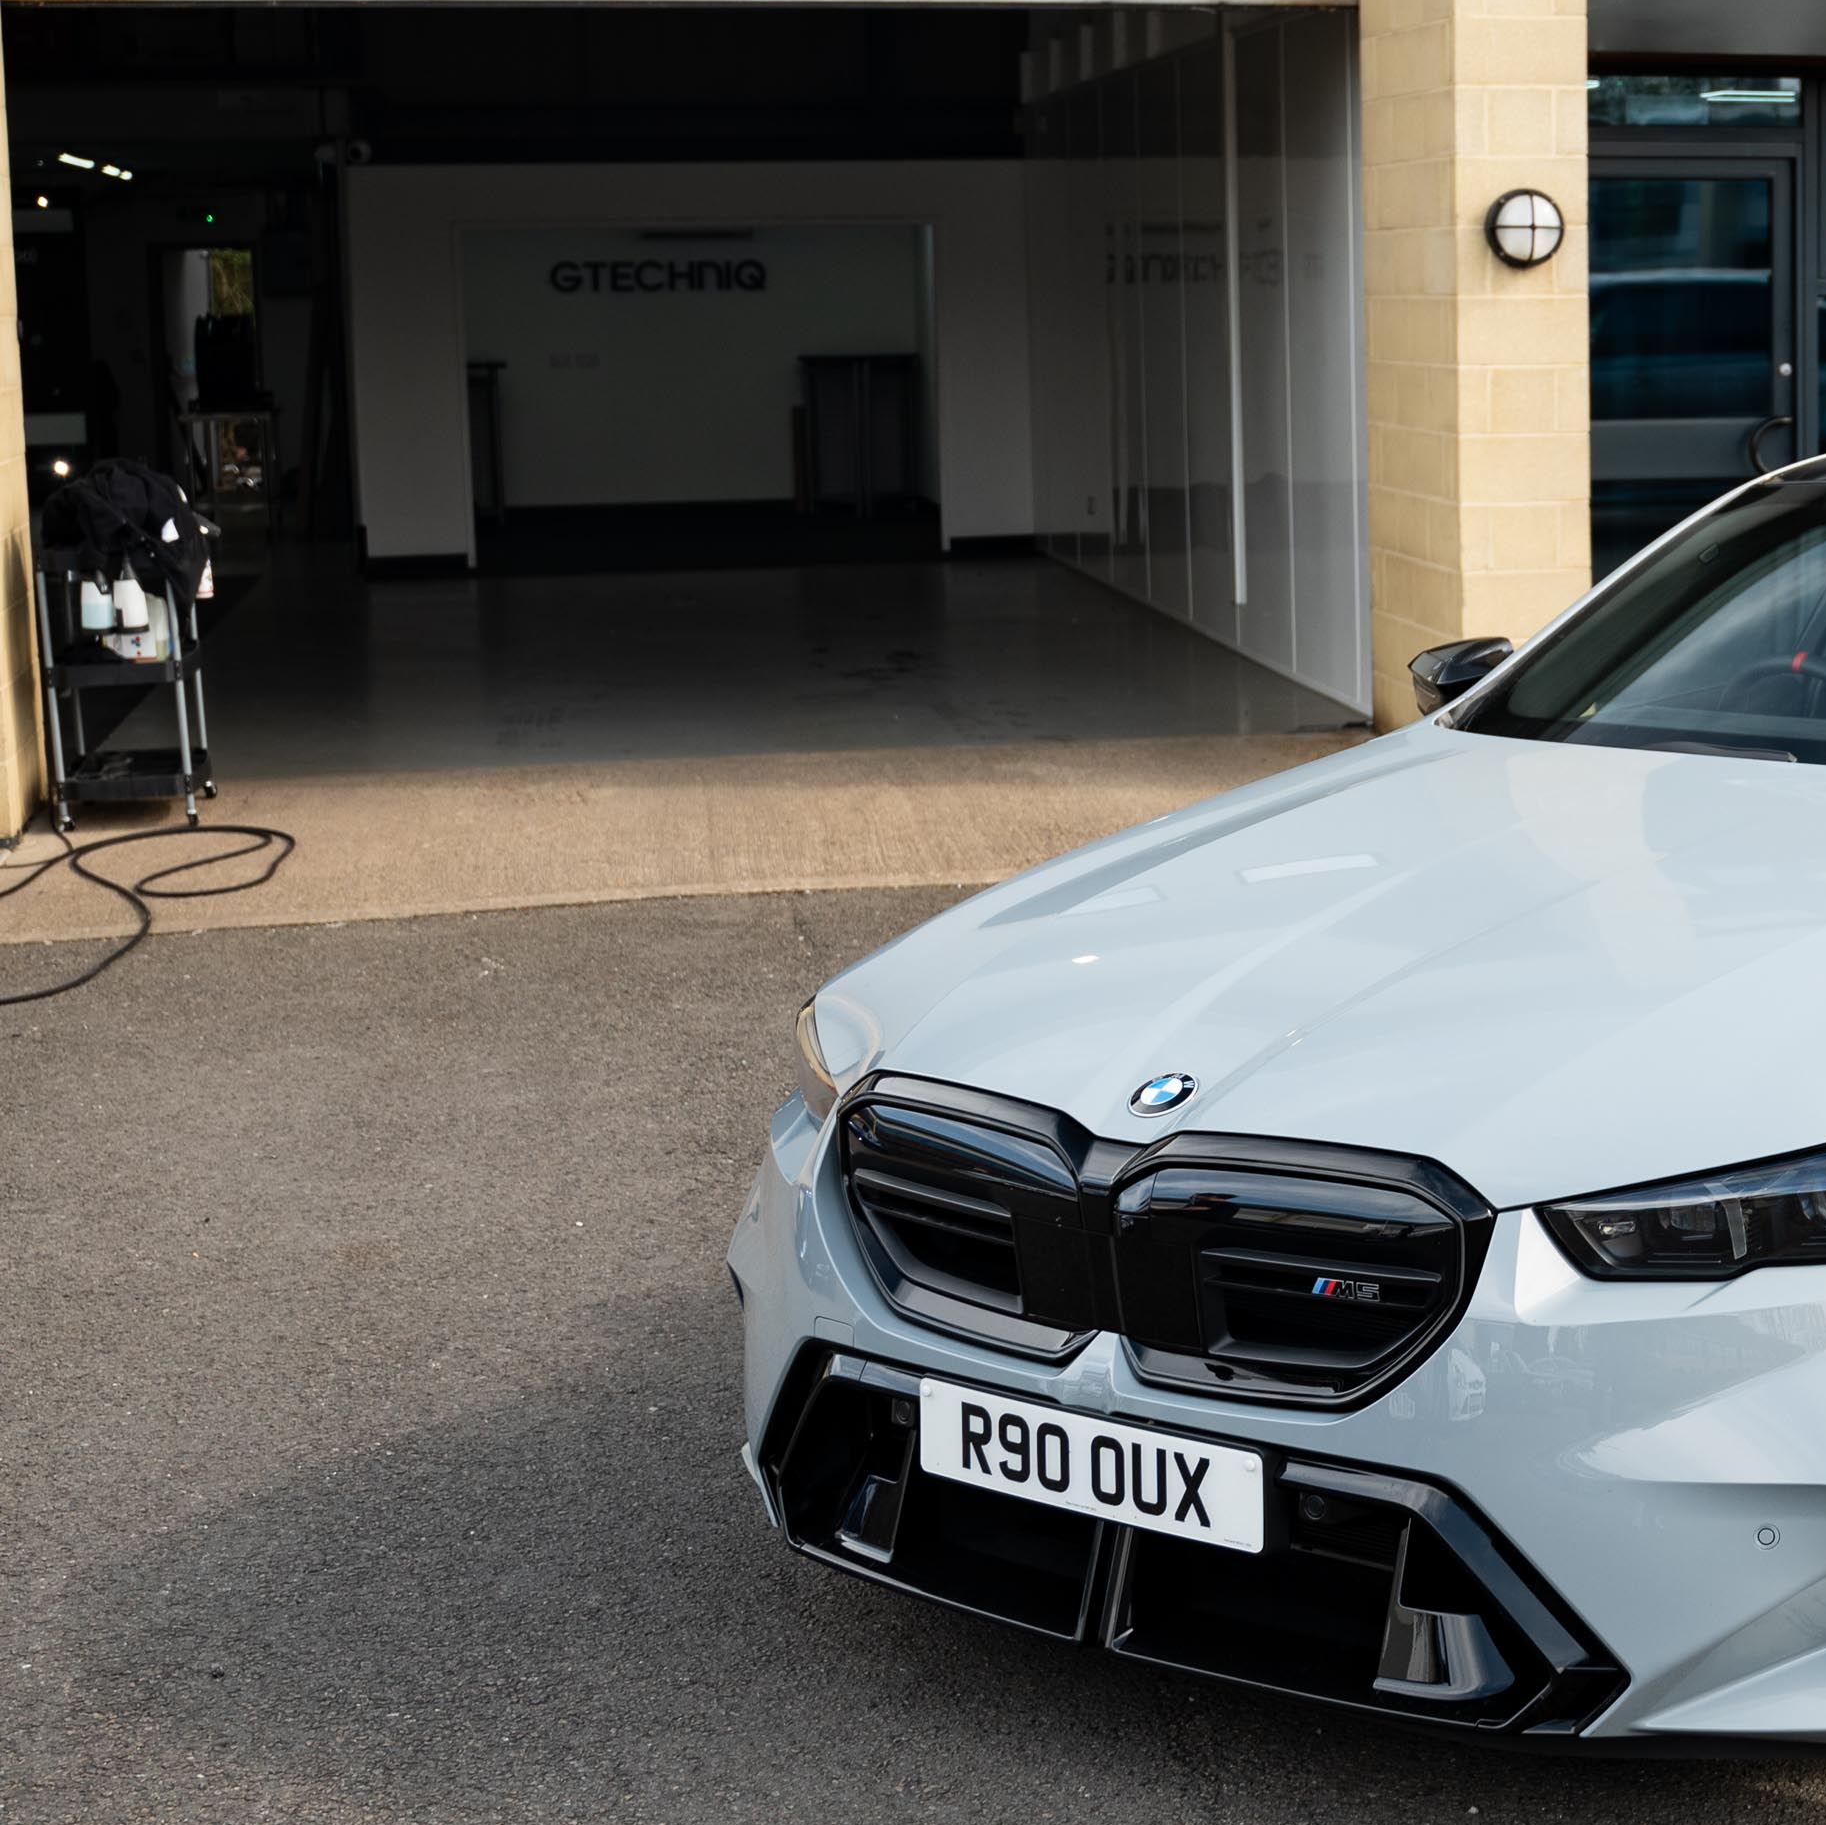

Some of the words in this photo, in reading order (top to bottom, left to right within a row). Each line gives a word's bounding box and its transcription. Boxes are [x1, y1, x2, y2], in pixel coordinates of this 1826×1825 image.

[550, 259, 767, 293] GTECHNIQ
[1332, 1278, 1381, 1302] M5
[961, 1401, 1071, 1493] R90
[1090, 1435, 1212, 1528] OUX
